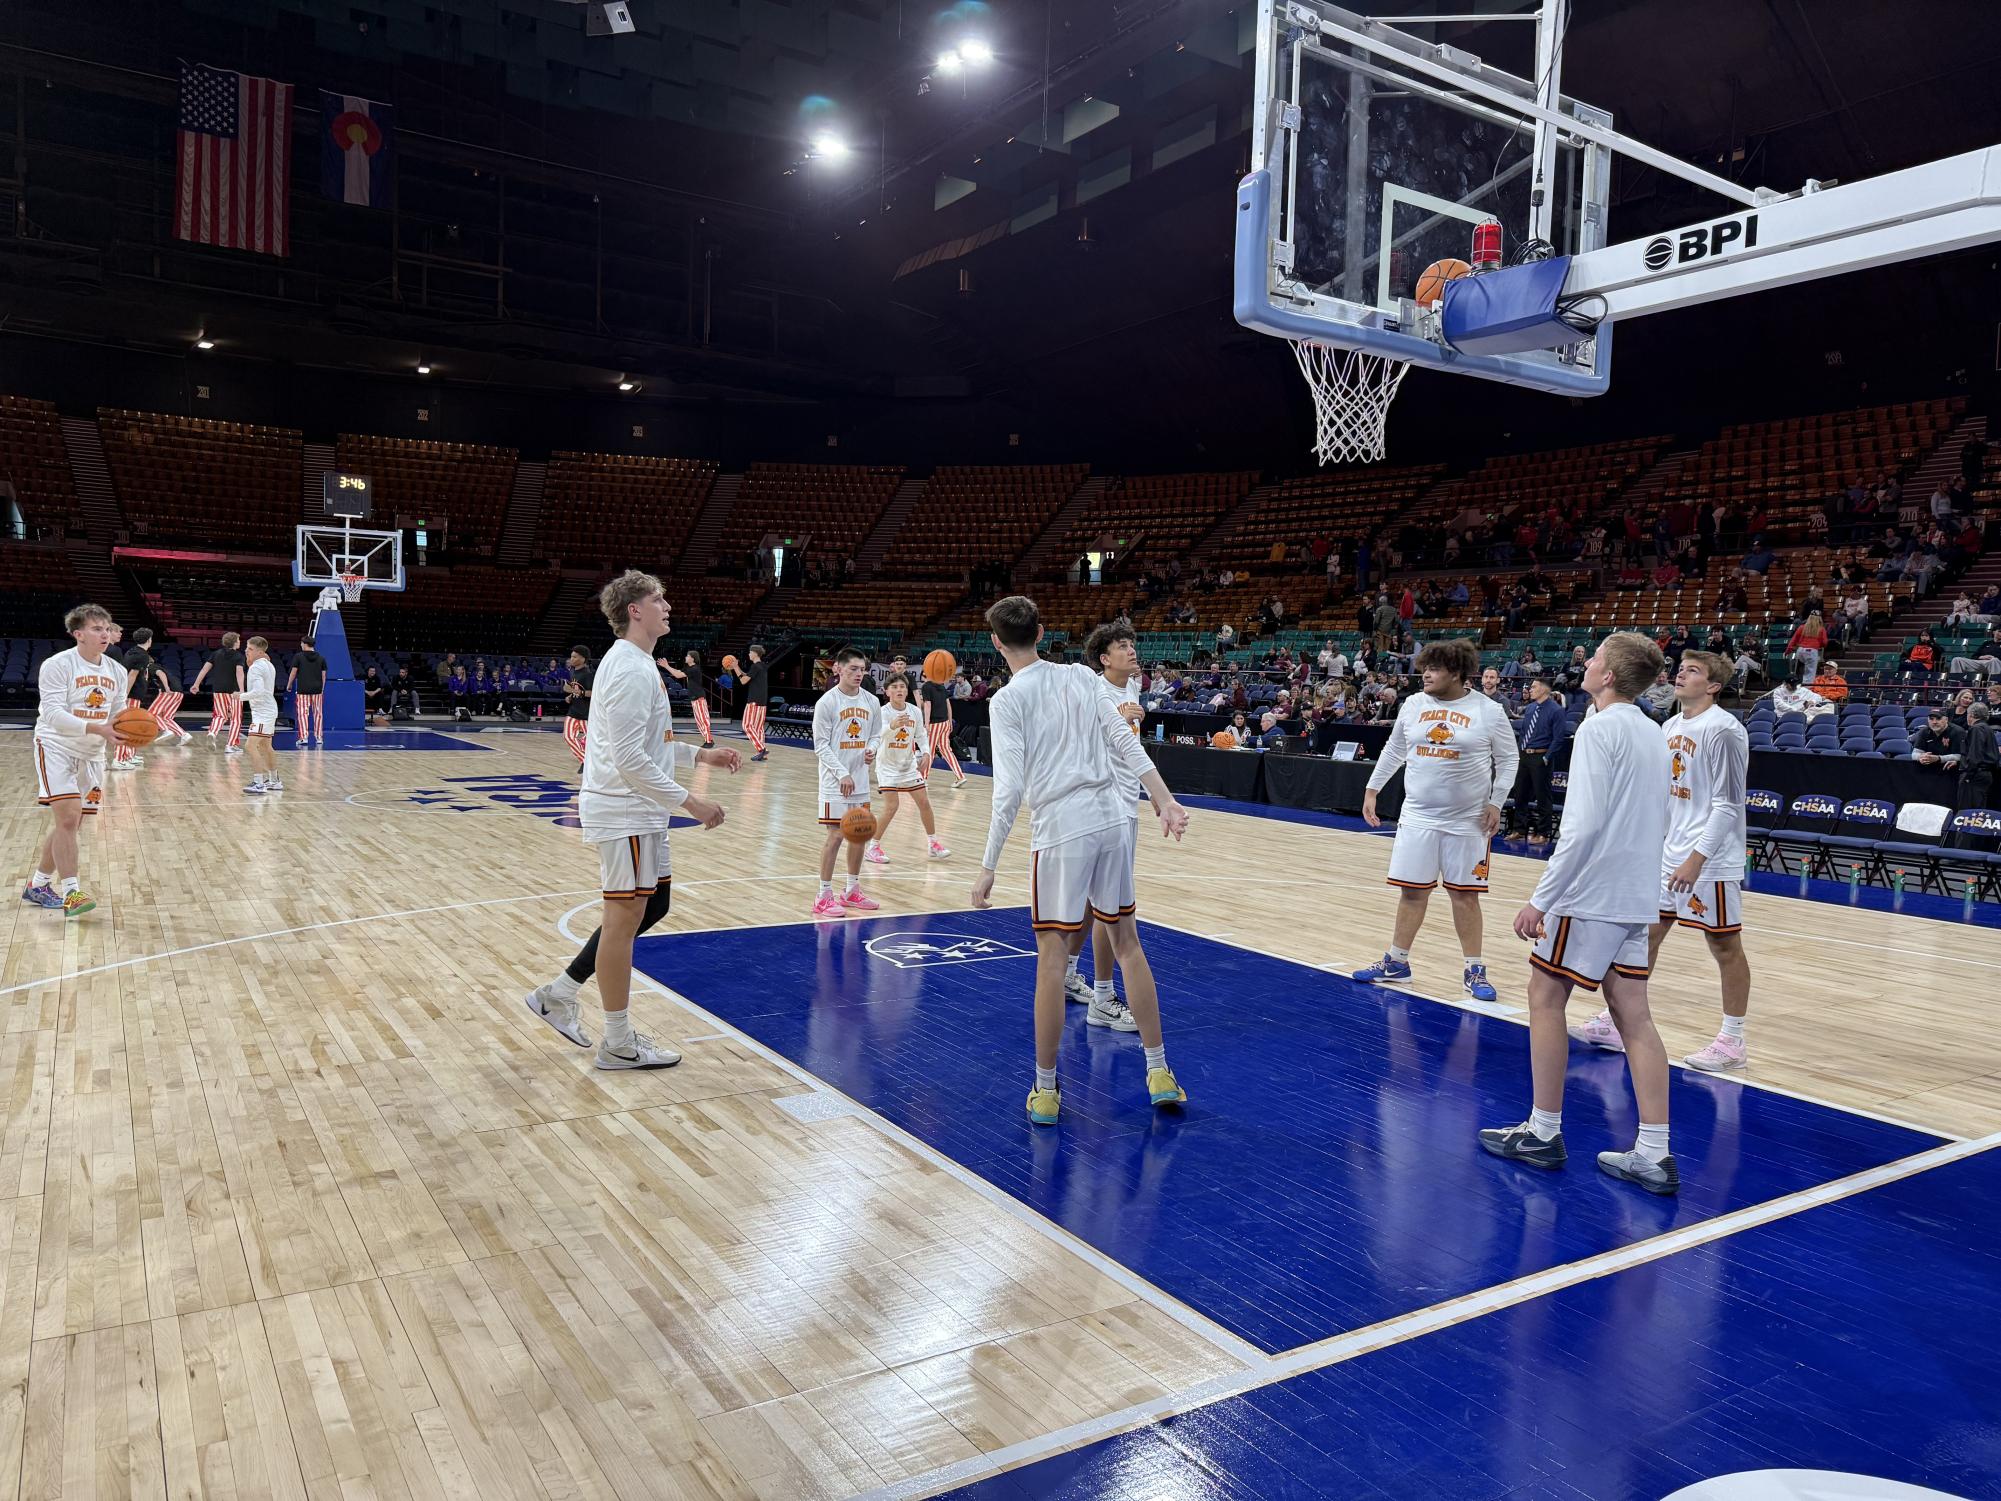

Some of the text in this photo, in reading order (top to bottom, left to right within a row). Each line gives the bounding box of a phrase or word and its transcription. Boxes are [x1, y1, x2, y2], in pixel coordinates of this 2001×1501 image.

[1678, 214, 1758, 263] BPI
[340, 476, 366, 490] 3:46
[1589, 540, 1602, 553] 109
[1450, 711, 1472, 728] CITY
[1176, 735, 1196, 745] POSS.
[1746, 796, 1778, 809] HSAA
[1792, 801, 1835, 814] CHSAA
[1843, 805, 1888, 819] CHSAA
[1953, 815, 2001, 830] CHSAA
